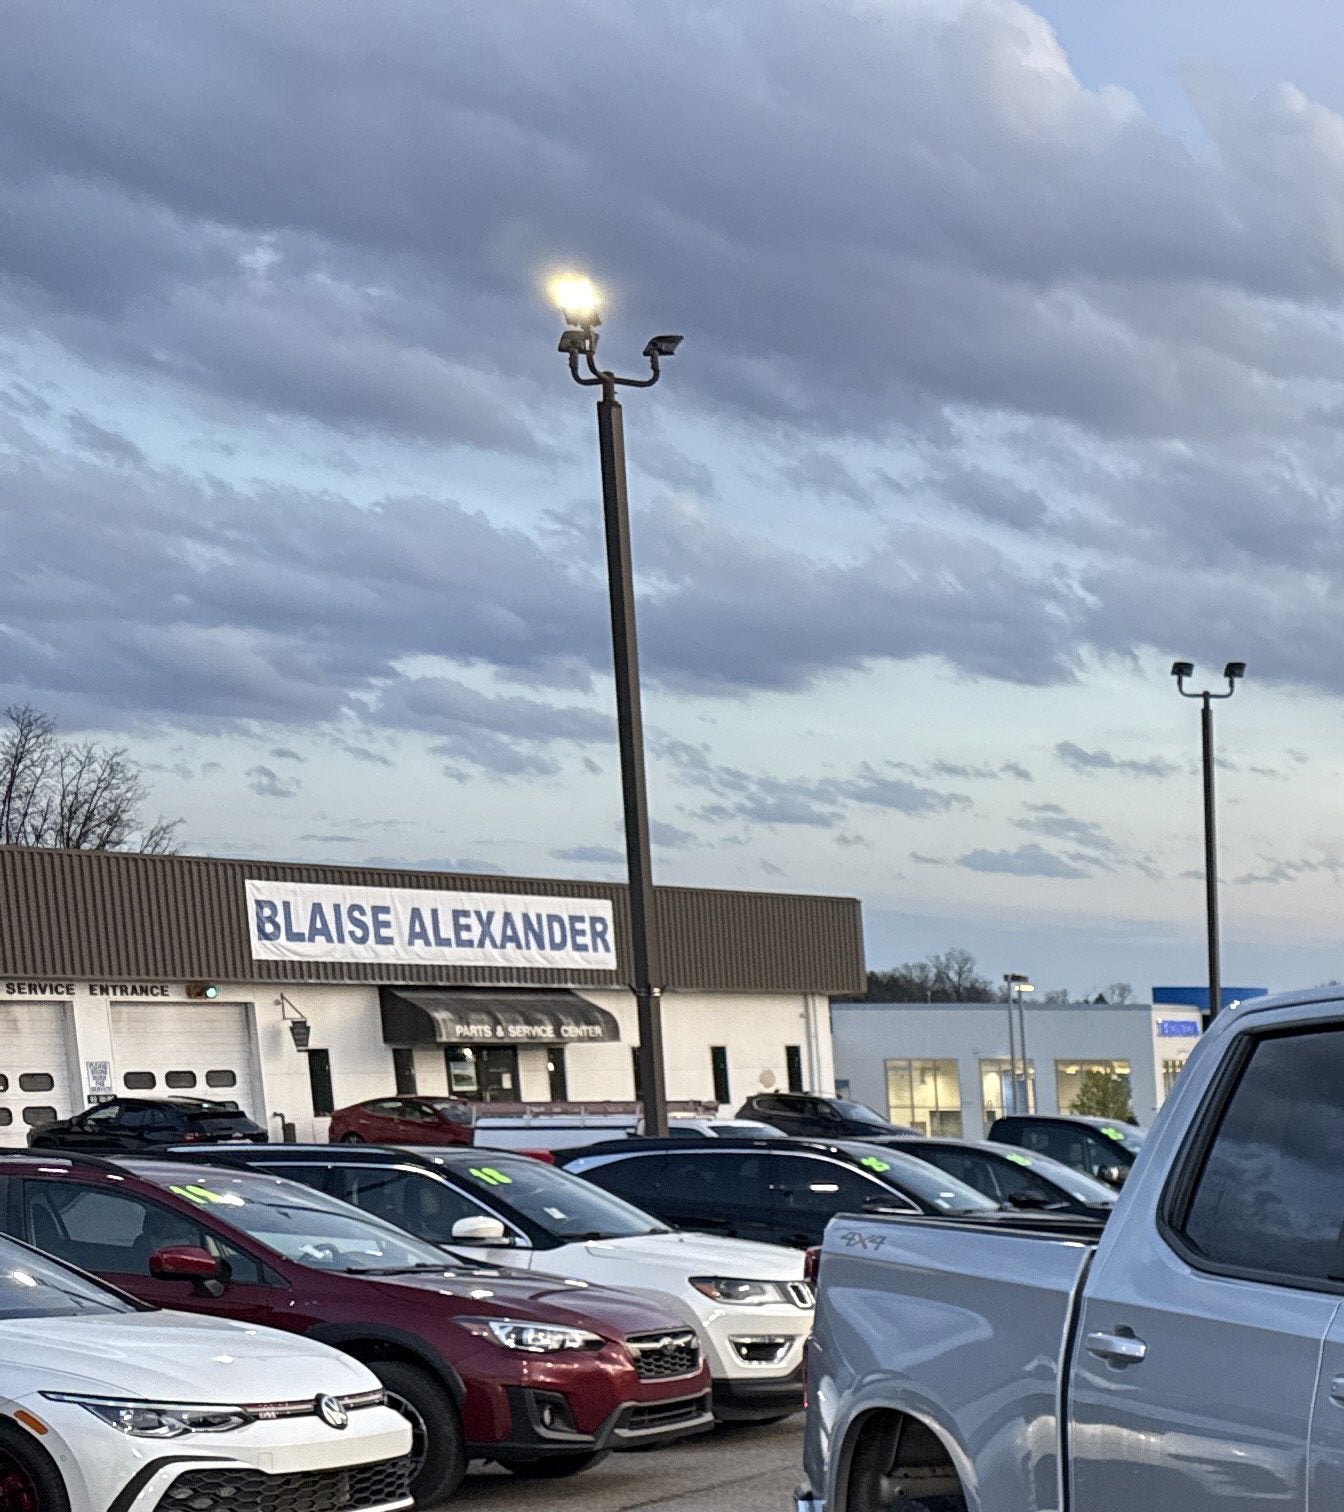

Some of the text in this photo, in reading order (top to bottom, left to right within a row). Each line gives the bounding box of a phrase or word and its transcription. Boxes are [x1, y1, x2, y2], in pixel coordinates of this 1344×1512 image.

[254, 899, 612, 953] BLAISE ALEXANDER
[6, 982, 170, 997] SERVICE ENTRANCE
[455, 1024, 603, 1038] PARTS & SERVICE CENTER
